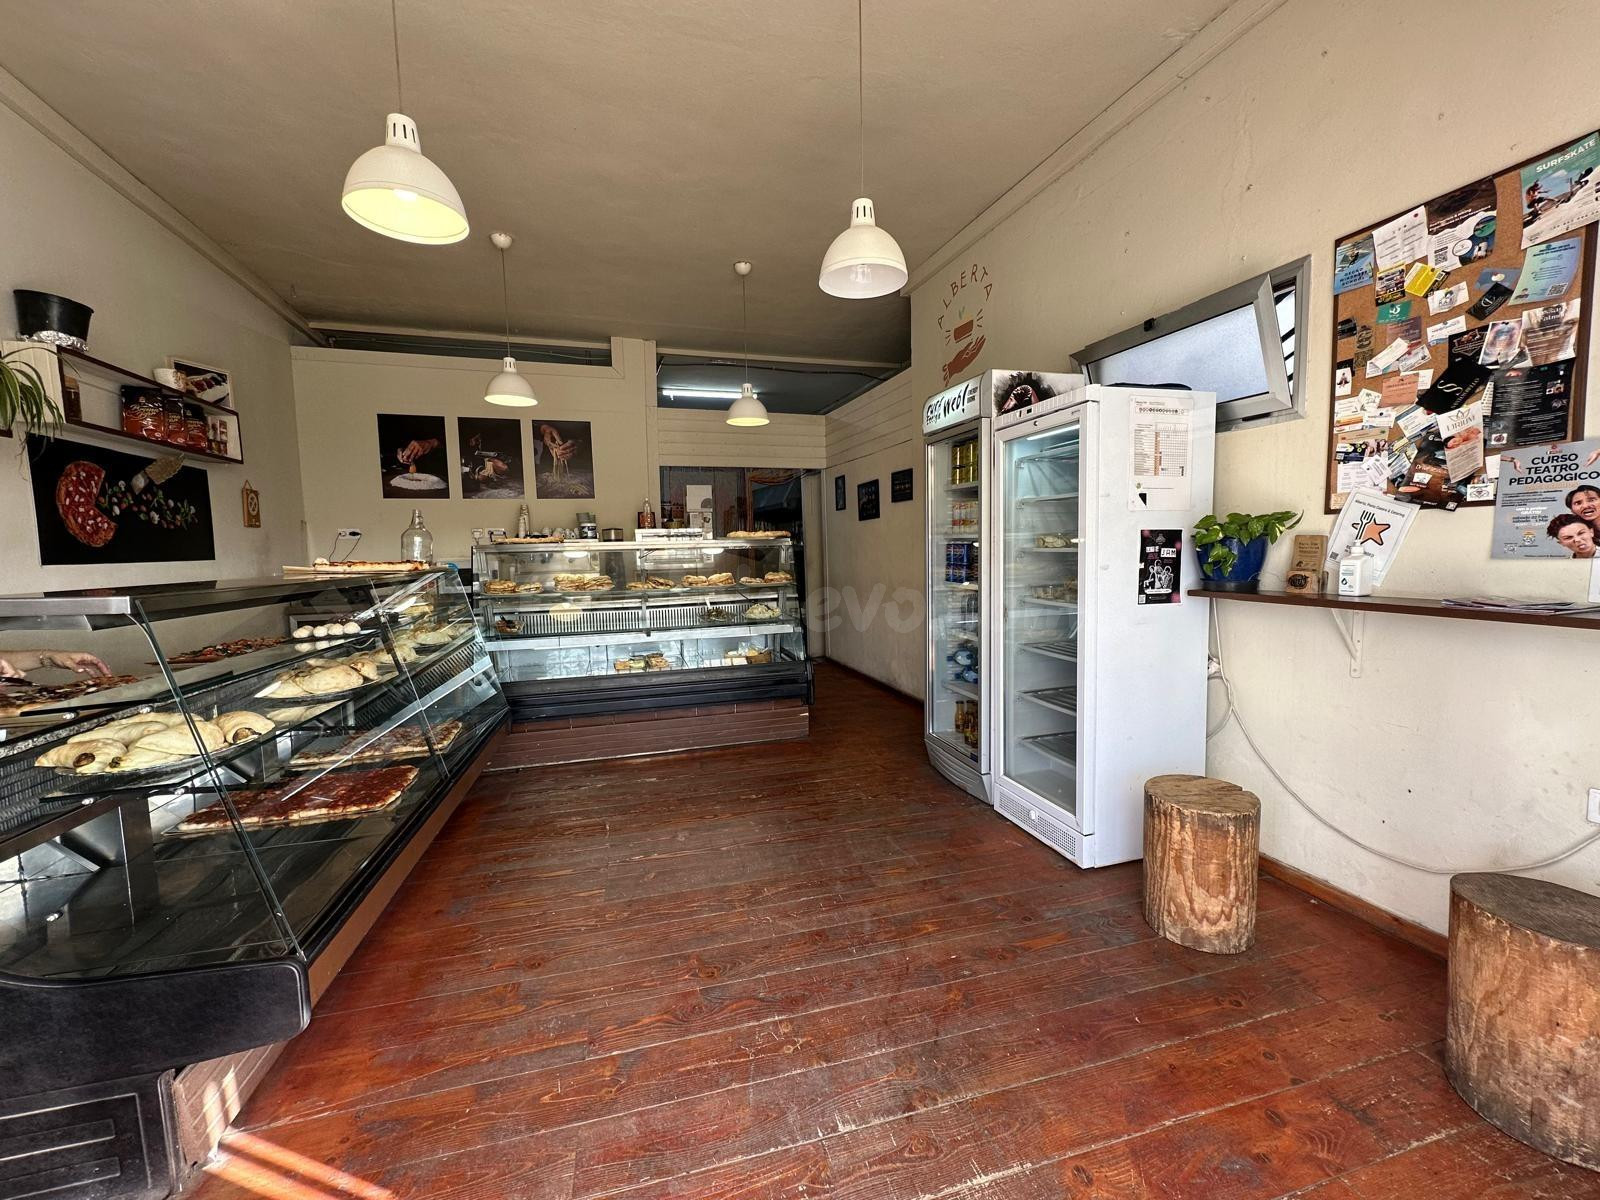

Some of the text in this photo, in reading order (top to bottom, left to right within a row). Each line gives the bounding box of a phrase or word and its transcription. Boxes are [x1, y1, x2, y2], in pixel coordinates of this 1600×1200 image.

[1535, 138, 1597, 174] SURFSKATE
[937, 263, 993, 330] ALBERTA
[1531, 453, 1579, 466] CURSO
[1526, 463, 1579, 475] TEATRO
[1509, 470, 1600, 486] PEDAGÓGICO
